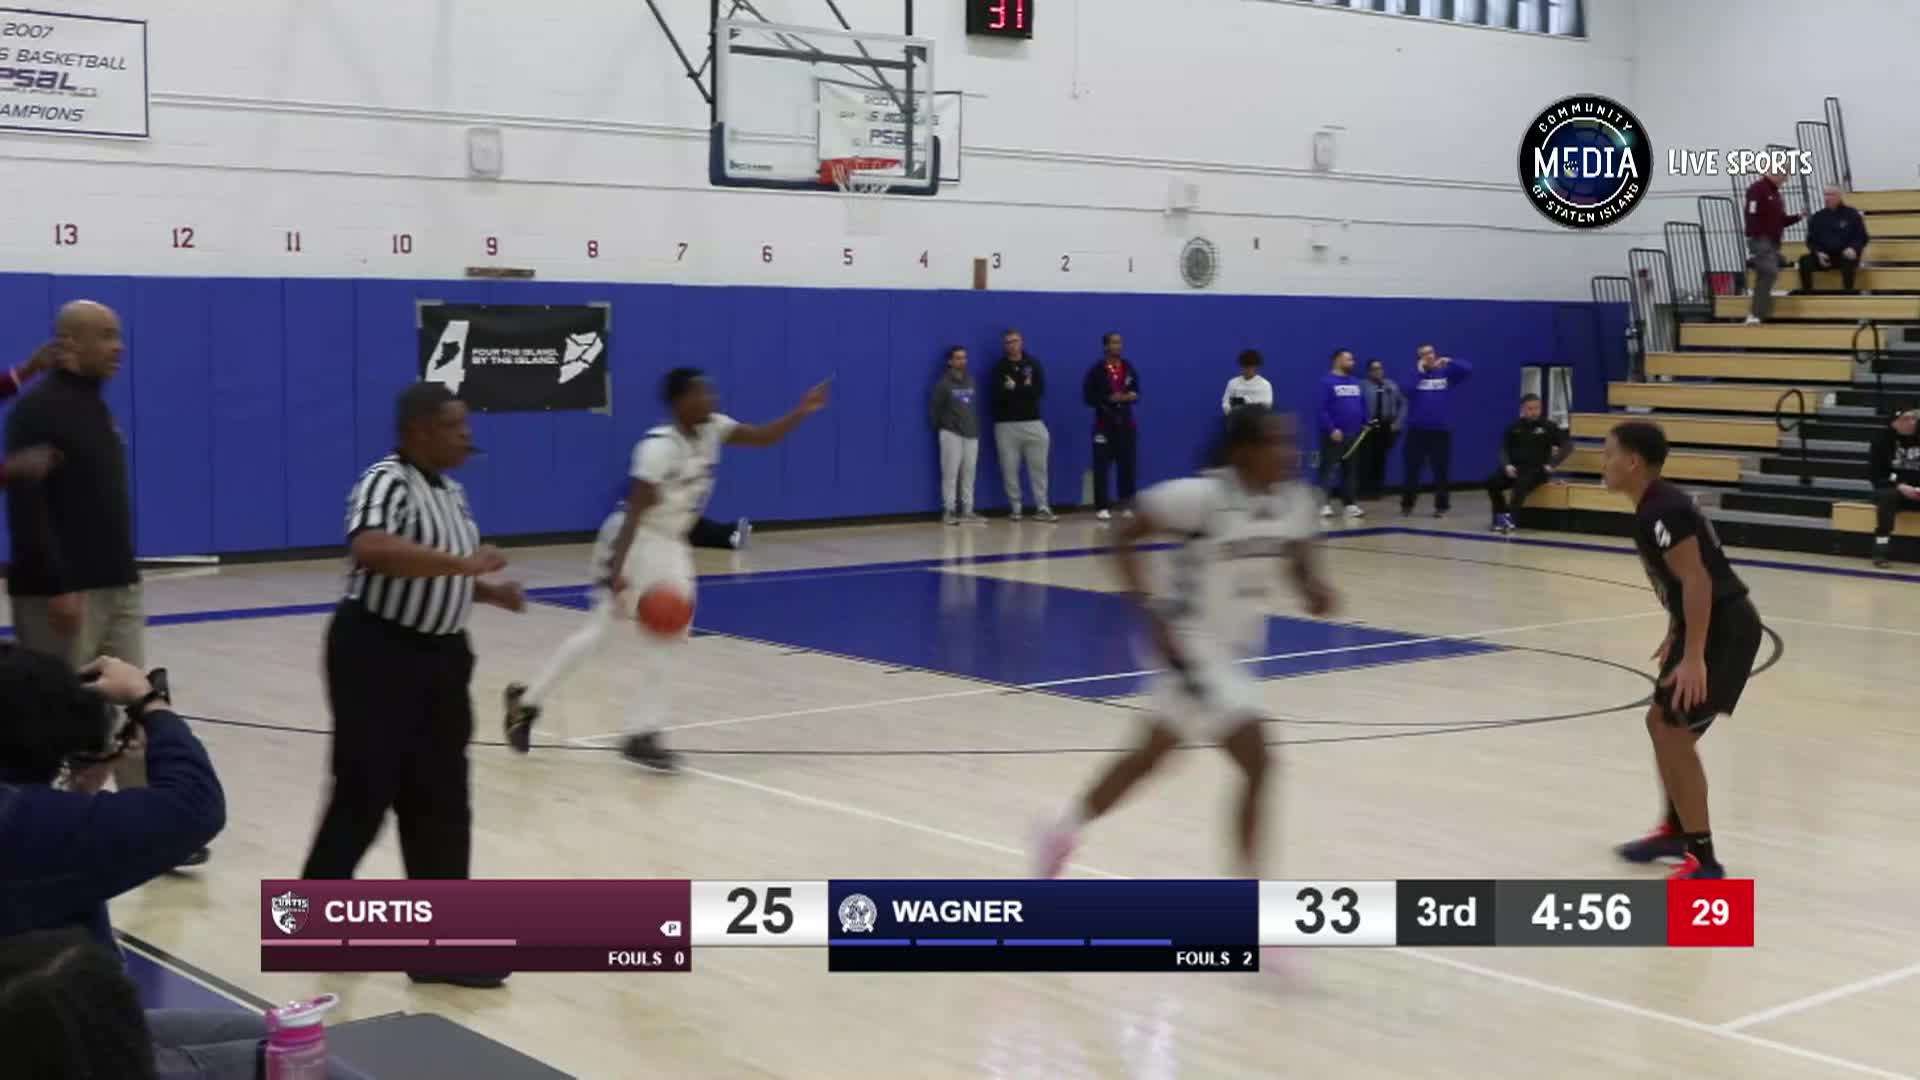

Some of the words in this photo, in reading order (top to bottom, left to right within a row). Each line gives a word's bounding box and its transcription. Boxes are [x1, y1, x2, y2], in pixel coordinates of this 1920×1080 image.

[2, 22, 54, 38] 2007
[16, 48, 127, 70] BASKETBALL
[54, 223, 78, 246] 13
[172, 227, 195, 249] 12
[286, 231, 301, 252] 11
[391, 234, 412, 255] 10
[486, 236, 498, 256] 9
[587, 240, 598, 258] 8
[677, 242, 689, 261] 7
[762, 245, 773, 263] 6
[843, 248, 853, 266] 5
[919, 251, 928, 268] 4
[992, 252, 1001, 270] 3
[1061, 255, 1070, 272] 2
[1128, 257, 1133, 272] 1
[471, 356, 488, 365] BY
[490, 356, 512, 365] THE
[502, 348, 520, 357] THE
